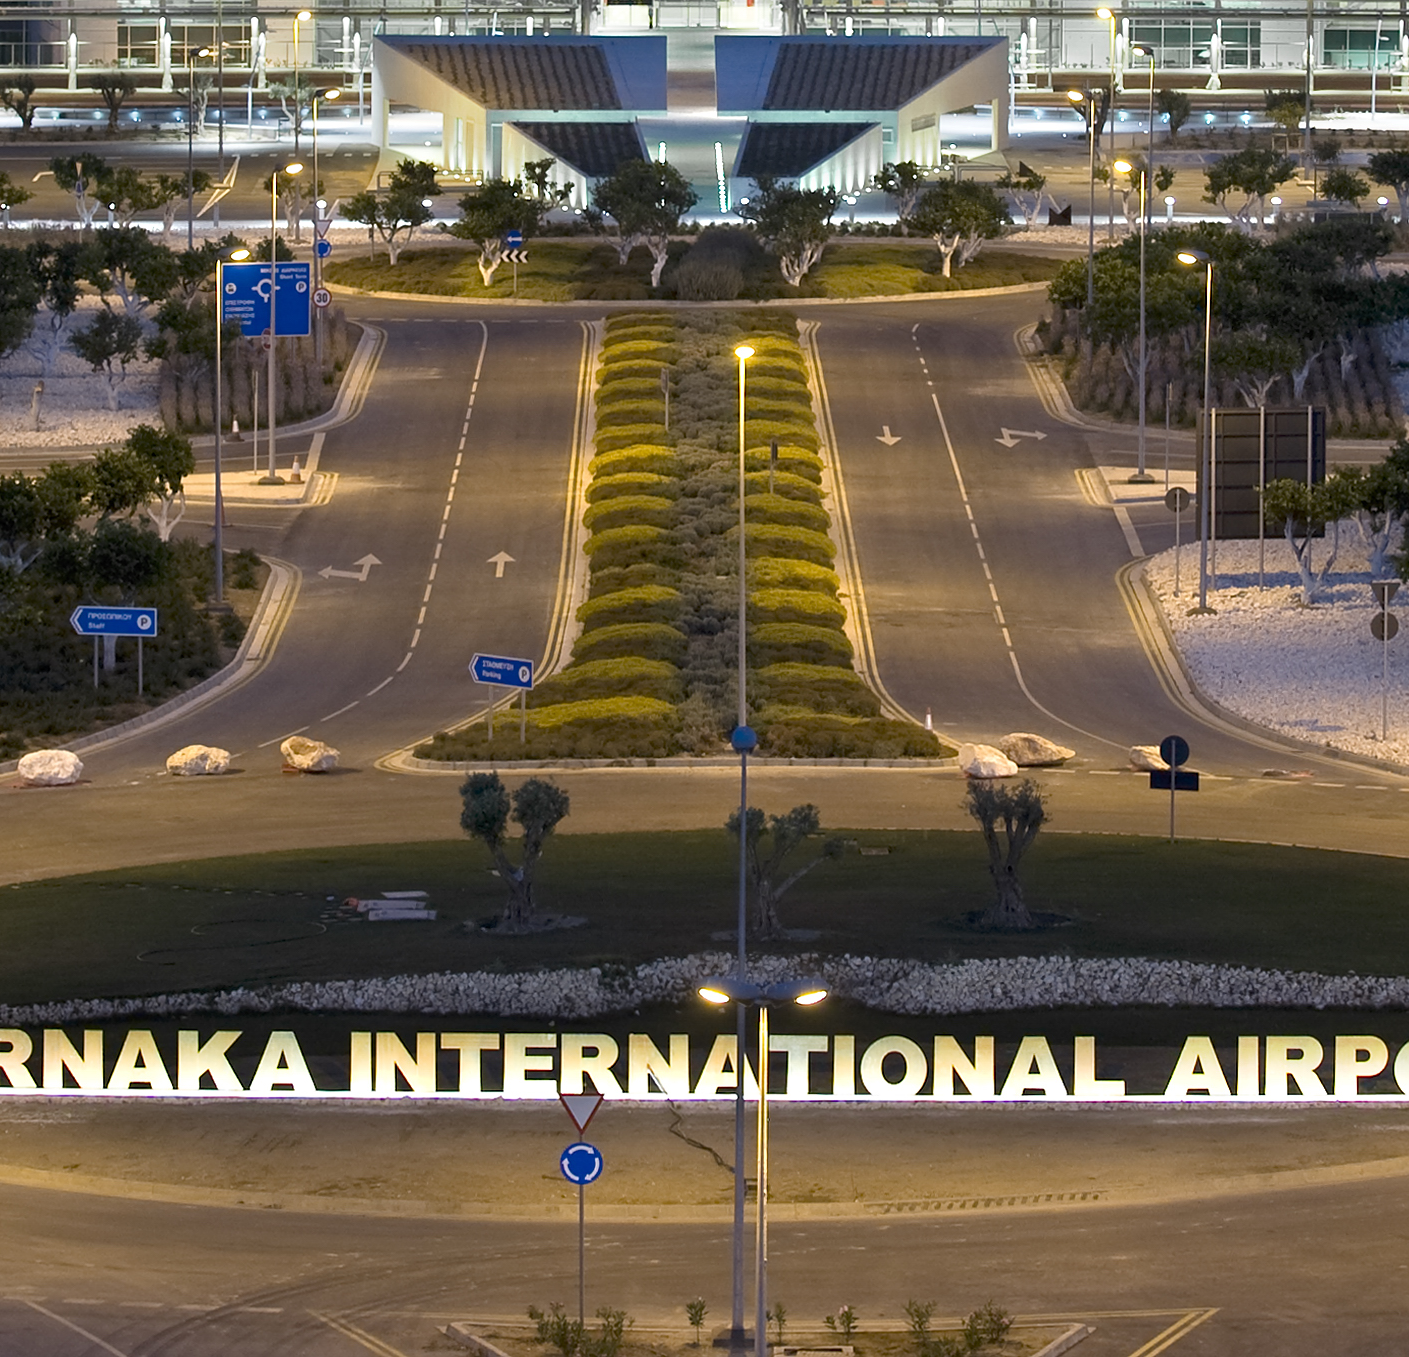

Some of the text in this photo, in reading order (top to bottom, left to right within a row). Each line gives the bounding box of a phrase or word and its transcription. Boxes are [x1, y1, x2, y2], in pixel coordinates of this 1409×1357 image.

[298, 283, 305, 292] P
[316, 293, 328, 303] 30
[140, 617, 148, 627] P
[521, 669, 527, 679] P
[350, 1031, 1126, 1097] INTERNATIONAL
